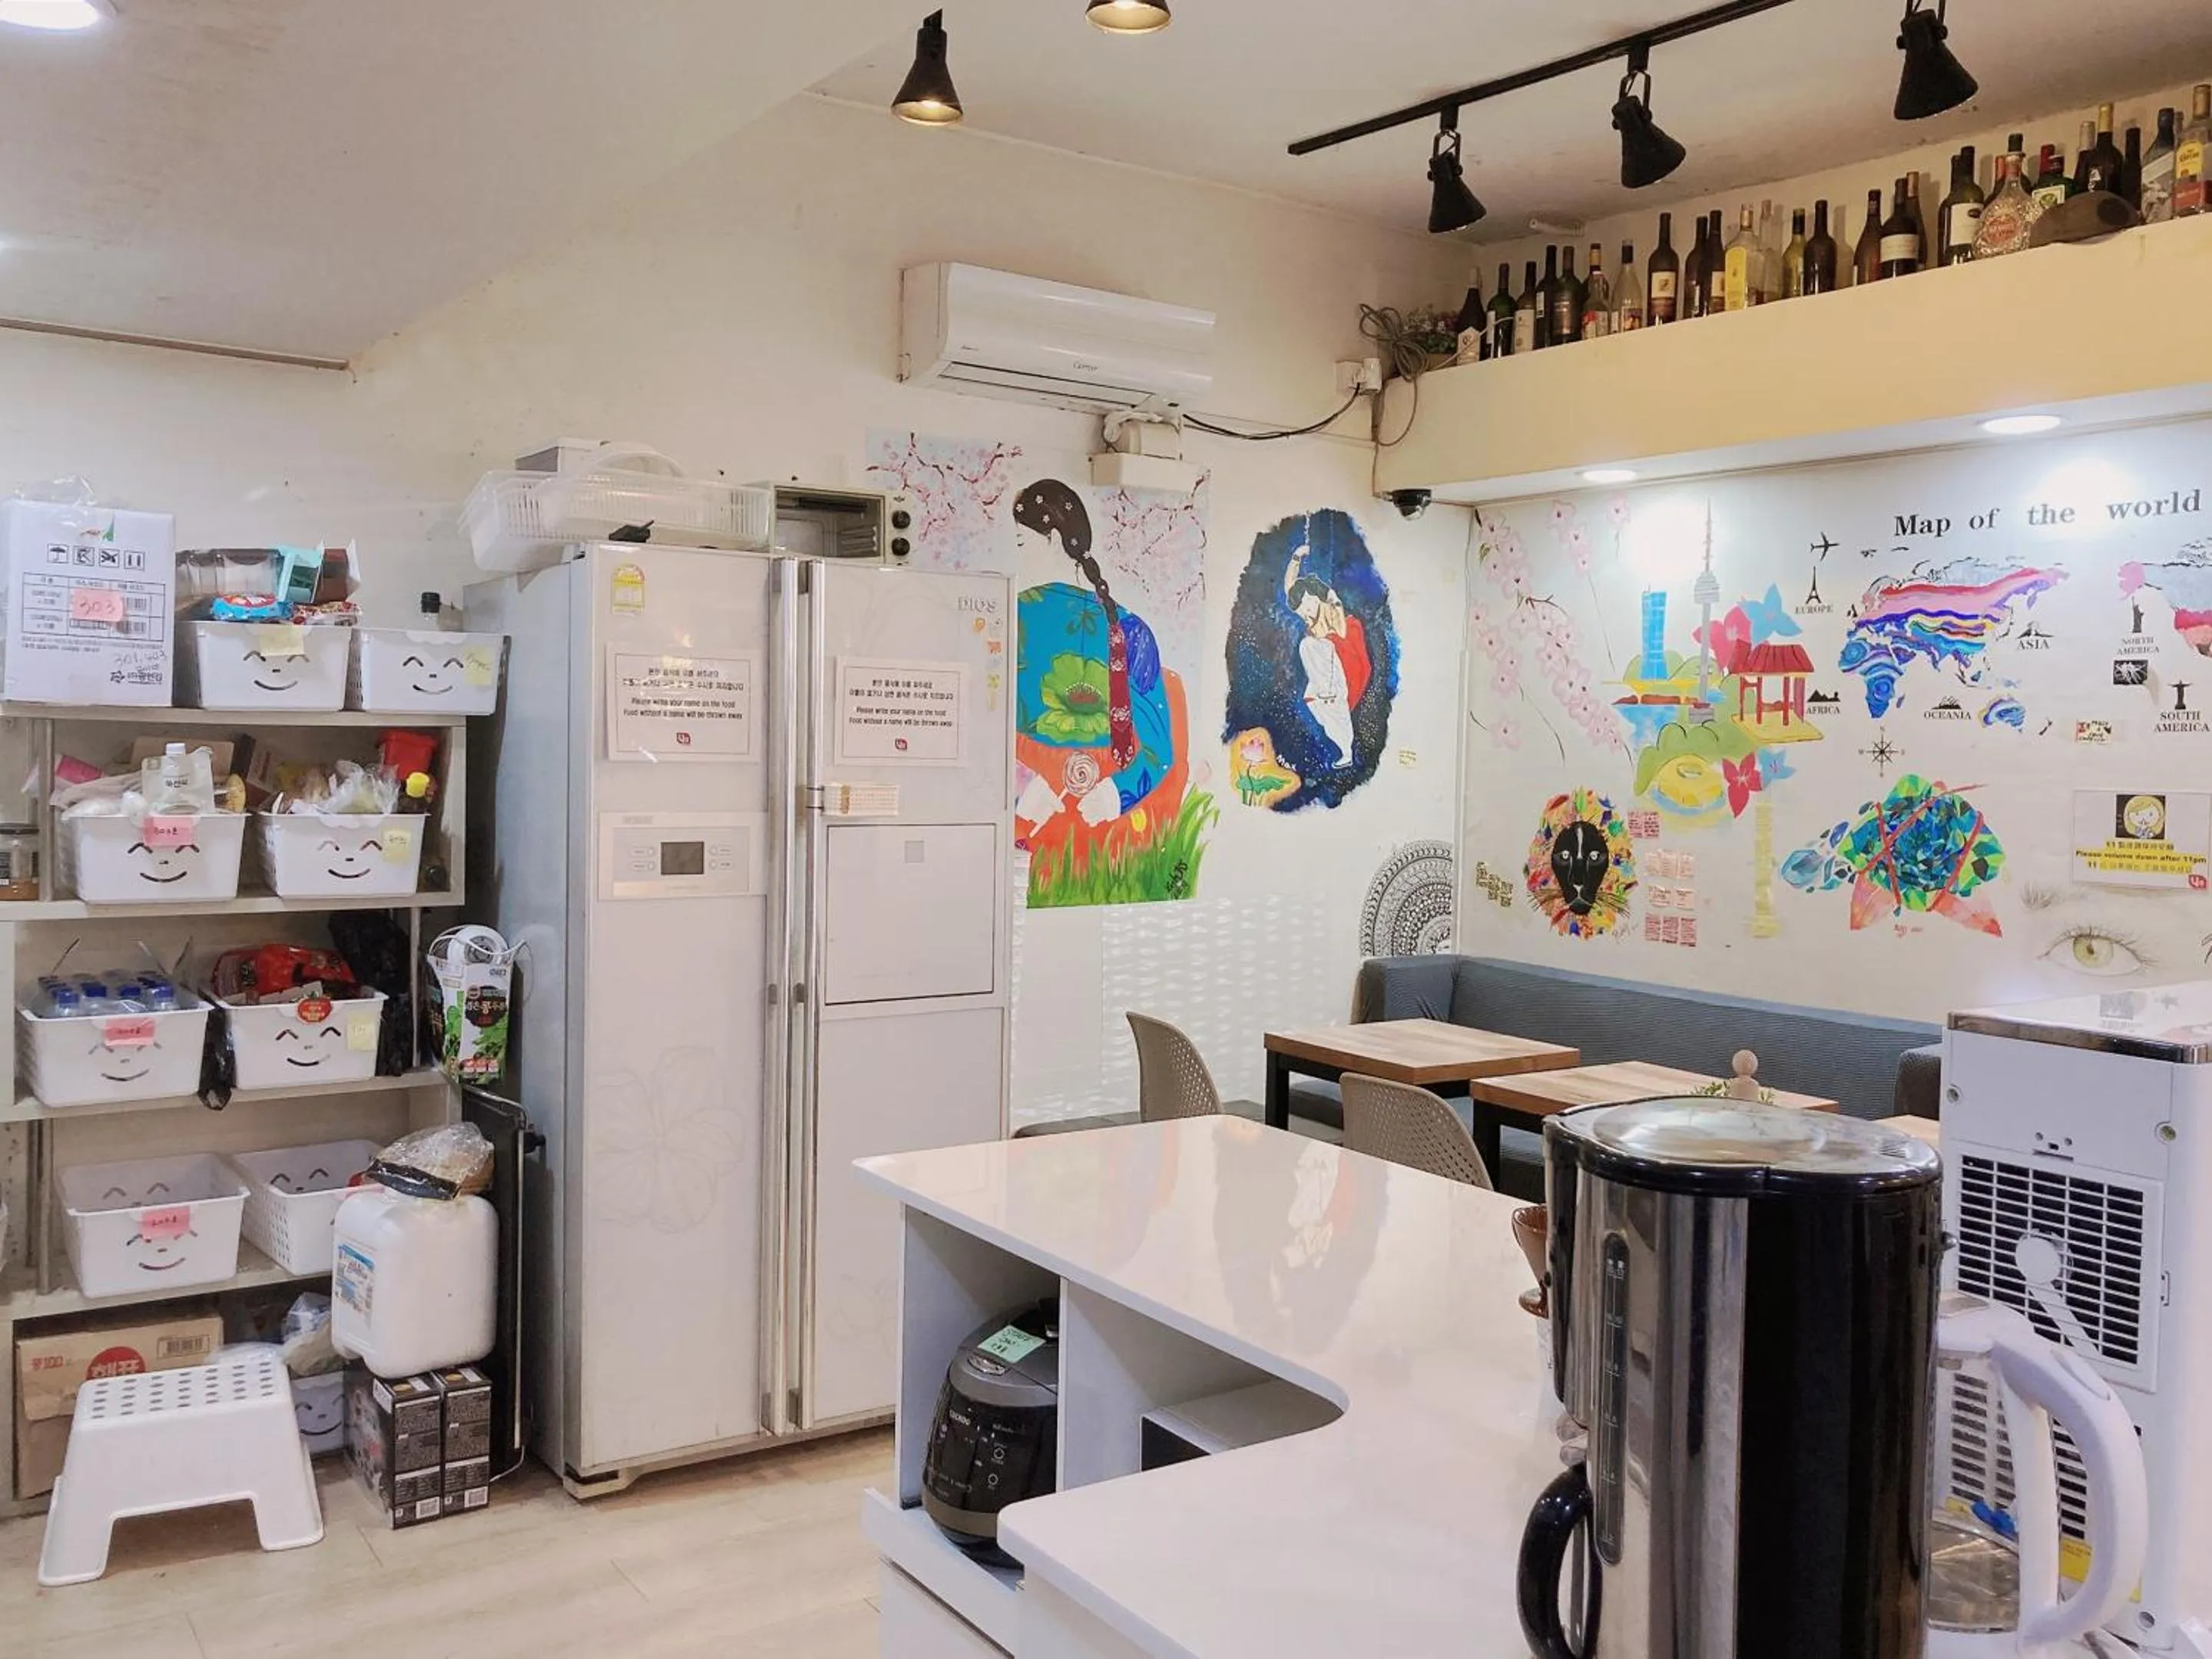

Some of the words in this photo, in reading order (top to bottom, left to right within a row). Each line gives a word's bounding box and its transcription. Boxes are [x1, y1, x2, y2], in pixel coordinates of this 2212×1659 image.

[1894, 514, 1951, 538] Map
[1969, 508, 1999, 530] of
[2027, 503, 2075, 526] the
[2107, 489, 2201, 520] world
[958, 596, 997, 614] DIOS
[1795, 605, 1833, 614] EUROPE
[2018, 639, 2050, 650] ASIA
[2118, 646, 2160, 655] AMERICA
[1806, 705, 1841, 715] AFRICA
[1924, 710, 1972, 721] OCEANIA
[2160, 711, 2200, 720] SOUTH
[2154, 722, 2210, 733] AMERICA
[1276, 754, 1296, 771] Max
[2183, 856, 2207, 864] 11pm
